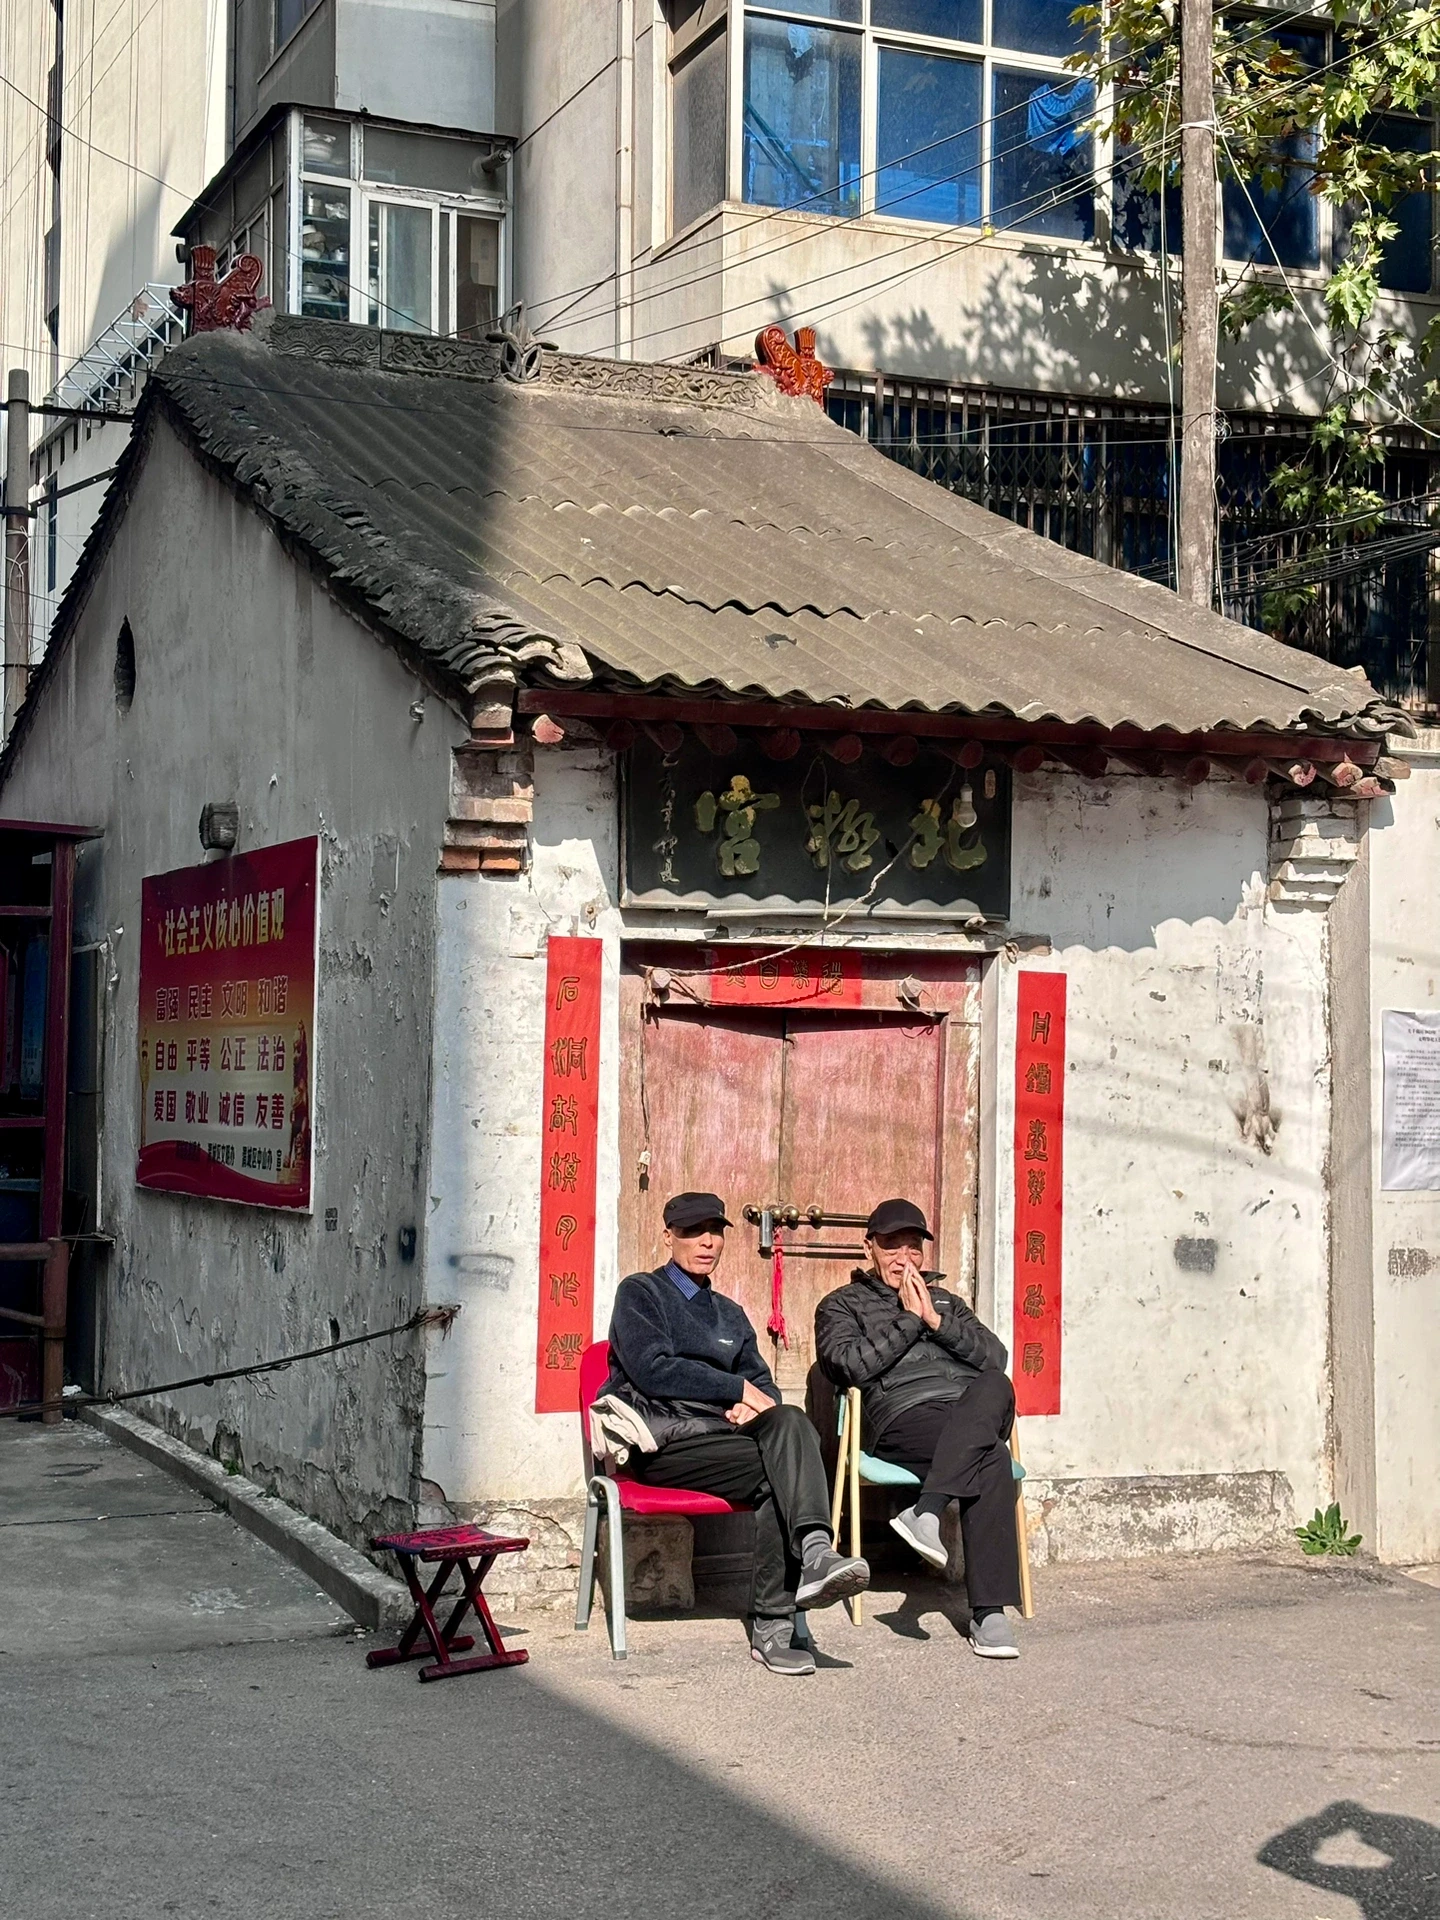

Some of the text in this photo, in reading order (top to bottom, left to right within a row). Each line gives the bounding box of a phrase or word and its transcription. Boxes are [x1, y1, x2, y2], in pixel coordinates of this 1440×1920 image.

[165, 887, 285, 958] 社会主义核心价值观
[156, 974, 288, 1022] 富强 民主 文明 和谐
[155, 1034, 286, 1071] 自由 平等 公正 法治
[154, 1089, 285, 1130] 爱国 敬业 诚信 友善
